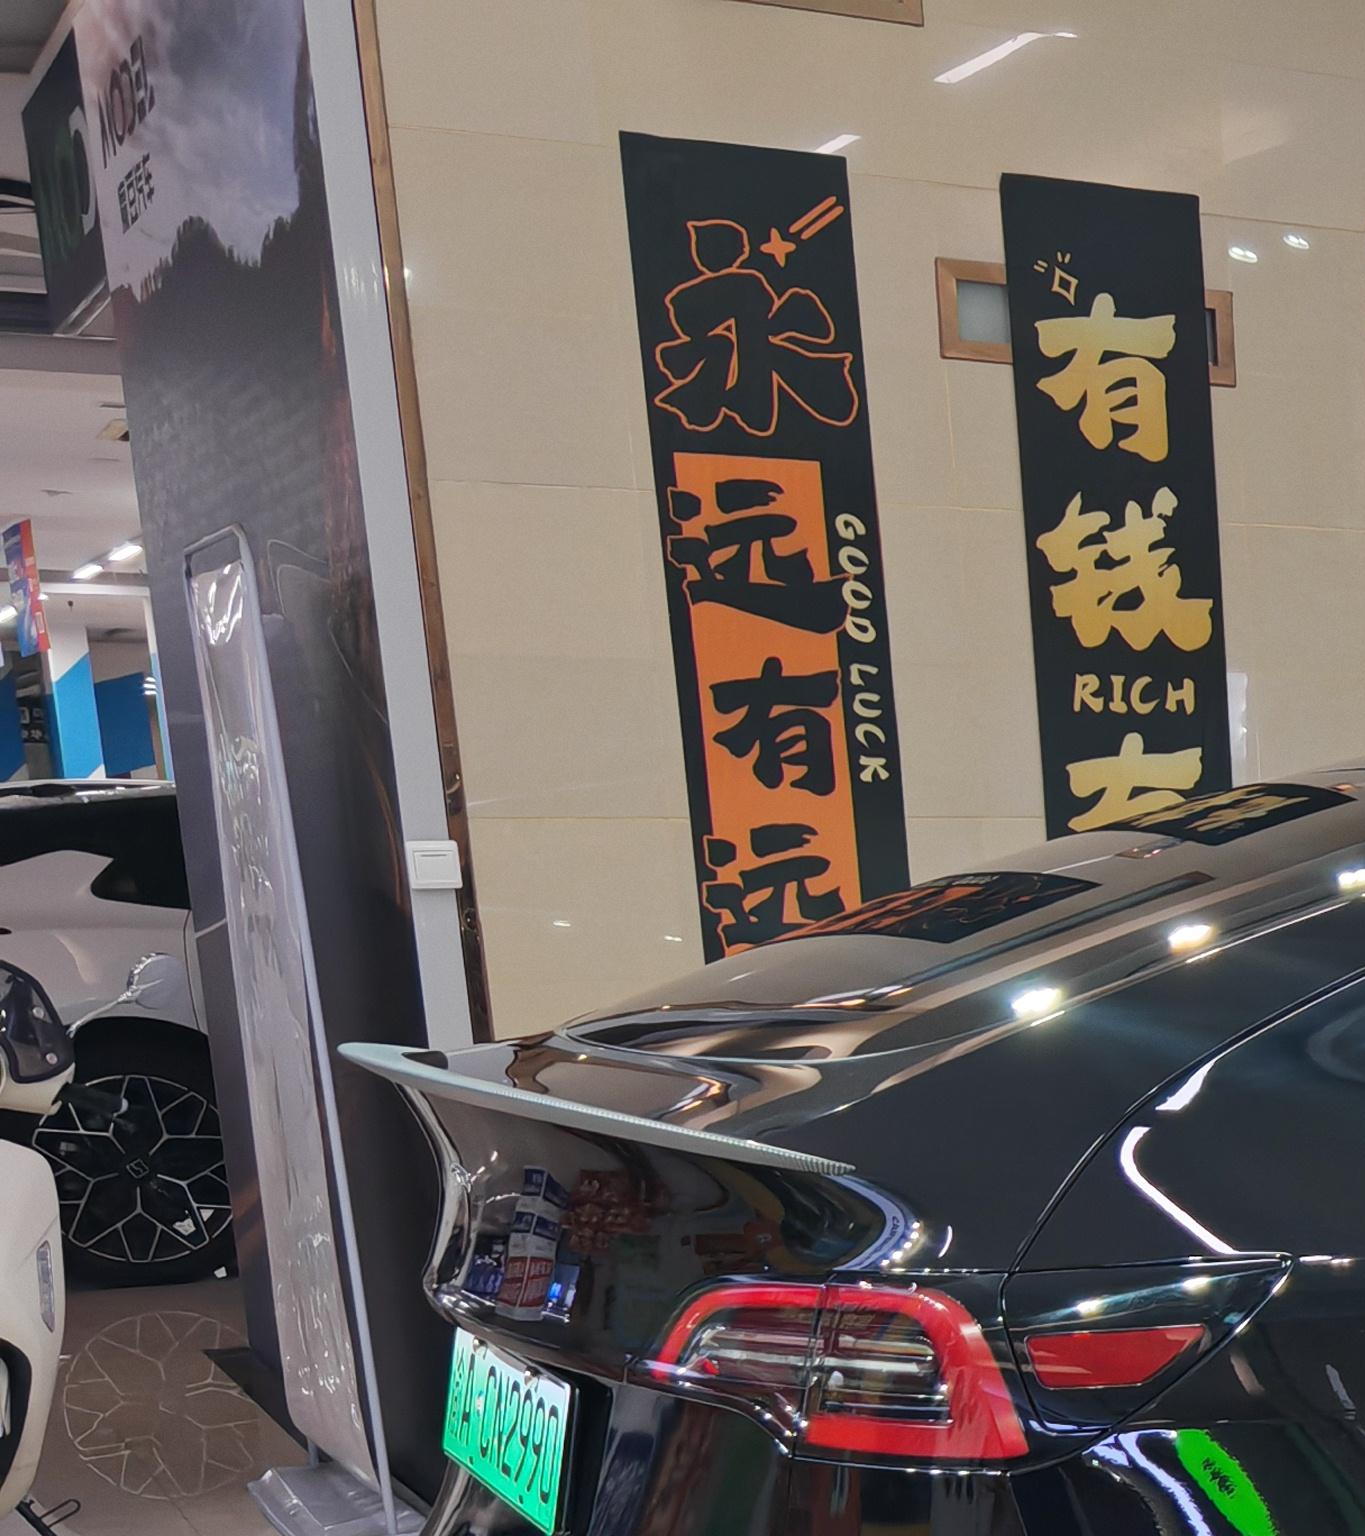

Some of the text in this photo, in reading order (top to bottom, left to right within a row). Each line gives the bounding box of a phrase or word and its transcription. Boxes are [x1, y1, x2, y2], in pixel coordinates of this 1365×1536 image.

[834, 512, 890, 783] GOOD LUCK
[1073, 672, 1196, 715] RICH
